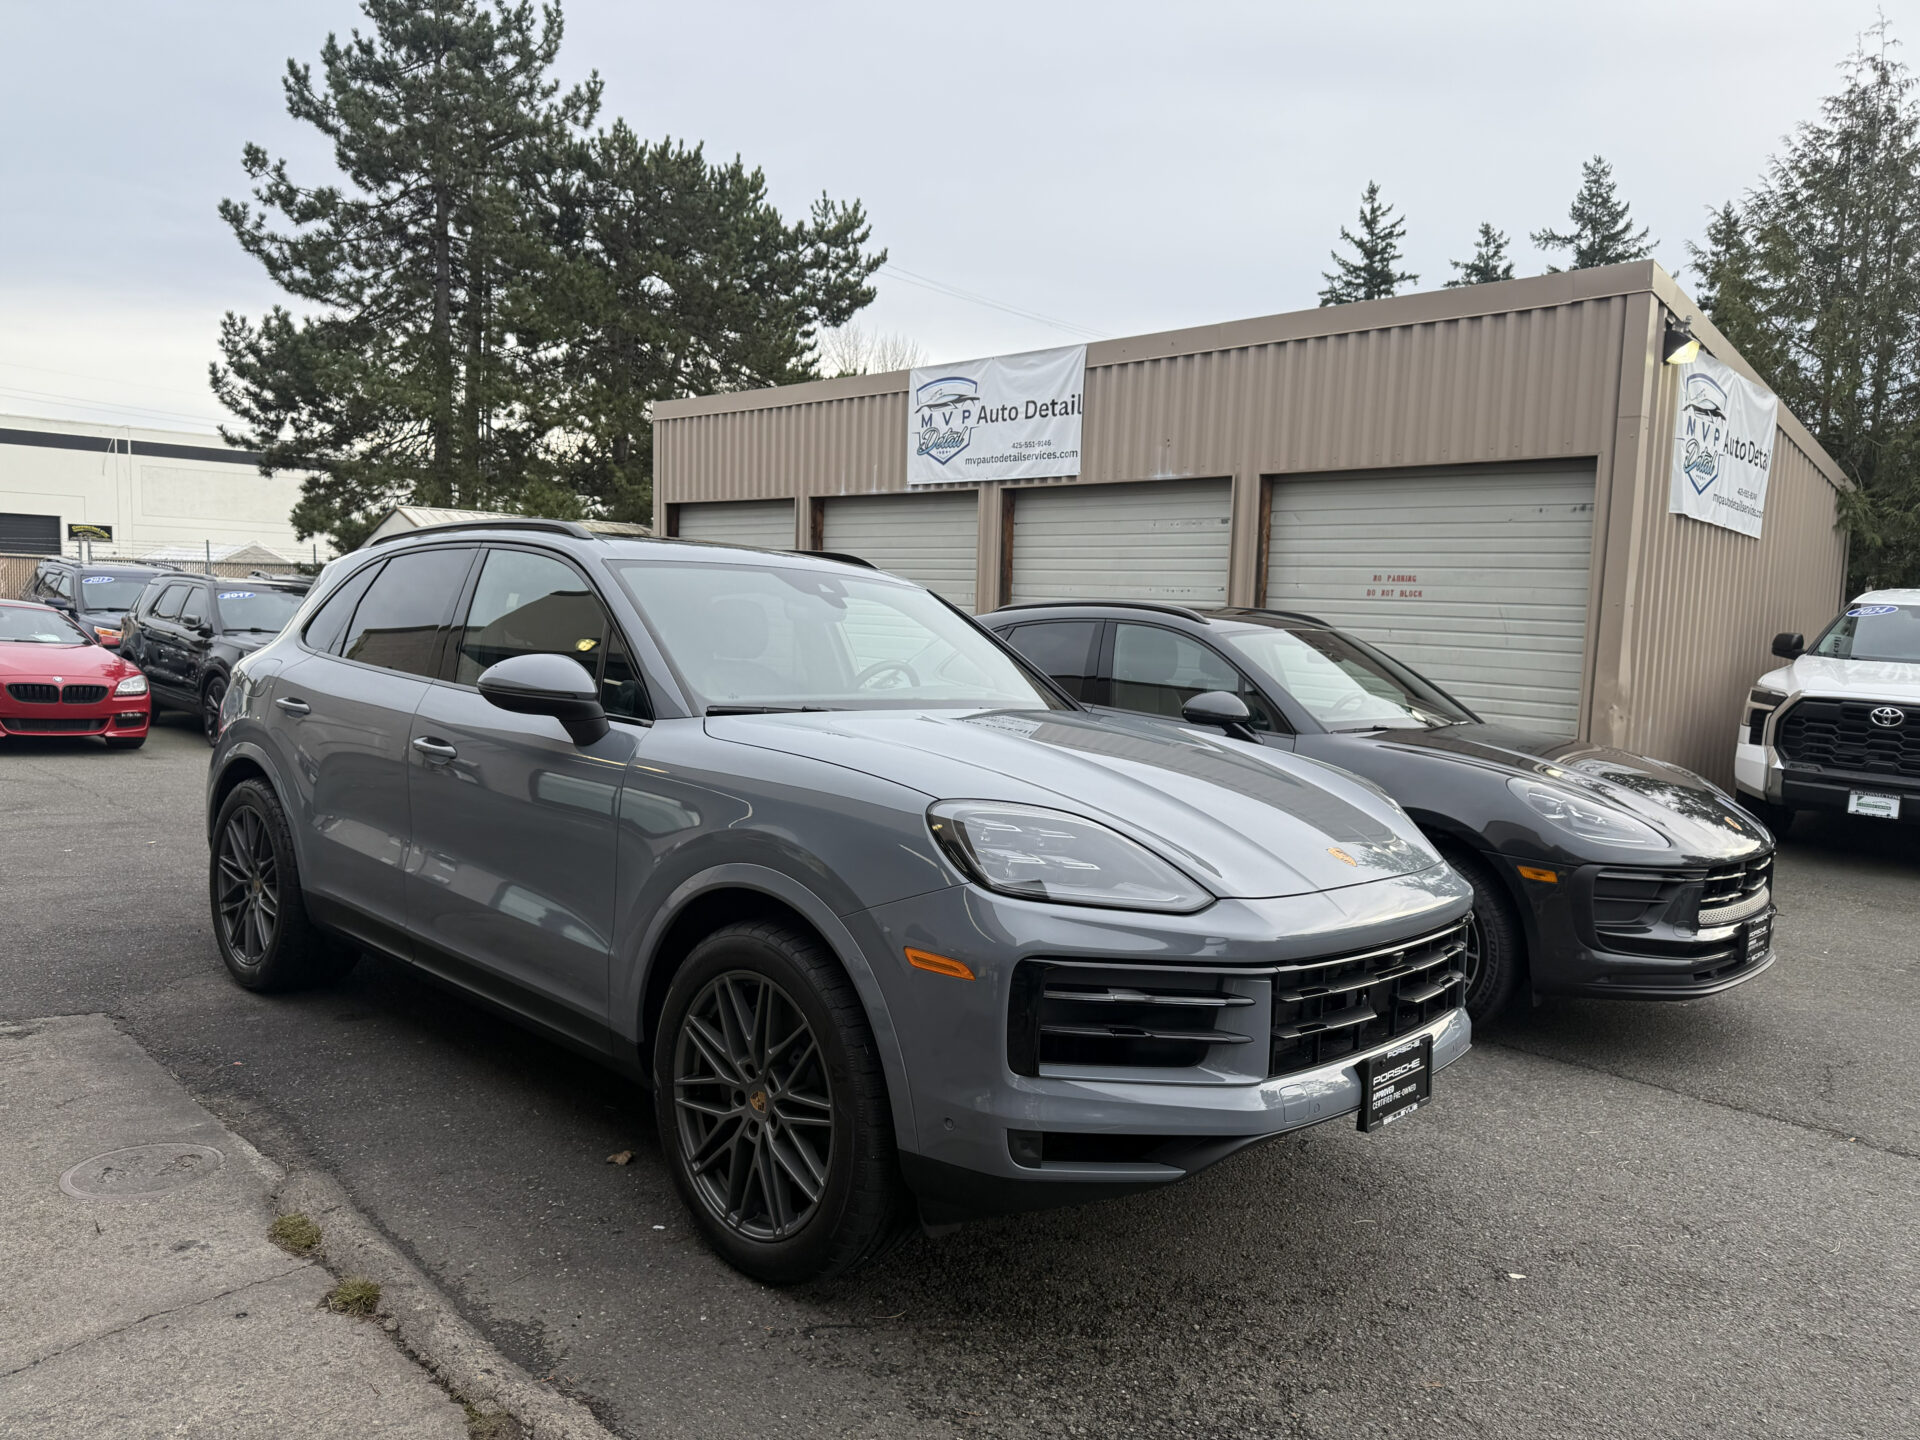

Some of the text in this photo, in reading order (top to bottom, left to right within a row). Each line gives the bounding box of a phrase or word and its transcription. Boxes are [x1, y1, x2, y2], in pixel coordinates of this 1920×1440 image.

[976, 393, 1082, 425] Auto Detail
[917, 426, 968, 456] Detail
[1723, 429, 1746, 461] Auto
[965, 449, 1078, 466] mvpautodetailservices.com
[1373, 574, 1417, 583] NO PARKING
[1366, 588, 1423, 598] DO NOT BLOCK
[1387, 1039, 1421, 1059] PORSCHE
[1373, 1057, 1421, 1086] PORSCHE
[1372, 1083, 1417, 1111] CERTIFIED PRE-OWNED
[1373, 1085, 1395, 1102] APPROVED
